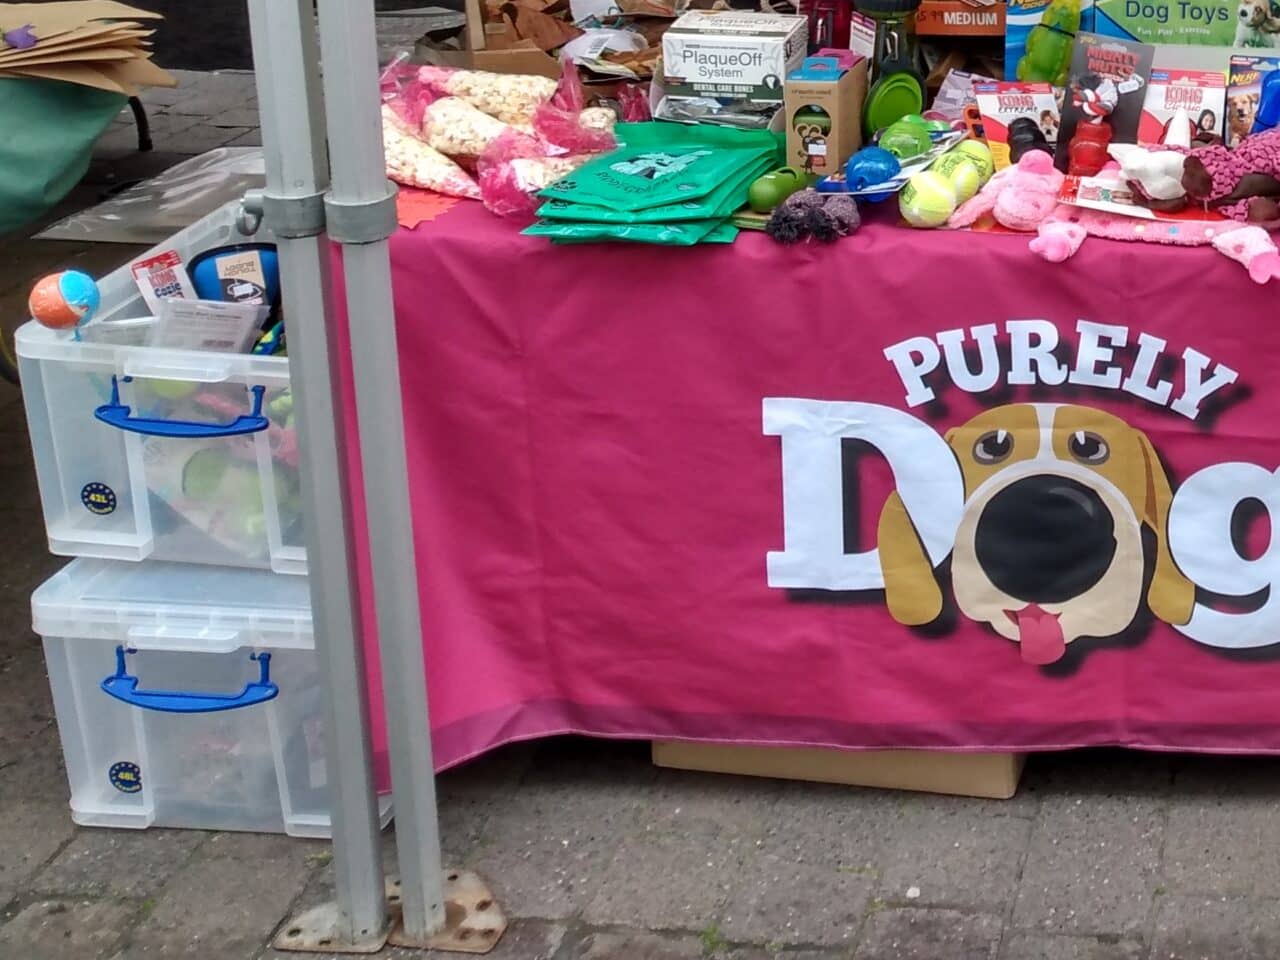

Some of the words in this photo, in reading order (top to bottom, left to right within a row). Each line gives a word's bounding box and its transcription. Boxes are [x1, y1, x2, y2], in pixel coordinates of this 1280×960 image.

[943, 11, 998, 26] MEDIUM
[1126, 0, 1169, 23] Dog
[1178, 0, 1230, 26] Toys
[1137, 26, 1152, 35] Fun
[1157, 28, 1174, 37] Play
[682, 49, 763, 67] PlaqueOff
[699, 66, 744, 79] System
[998, 95, 1034, 107] KONG
[883, 318, 1239, 421] PURELY
